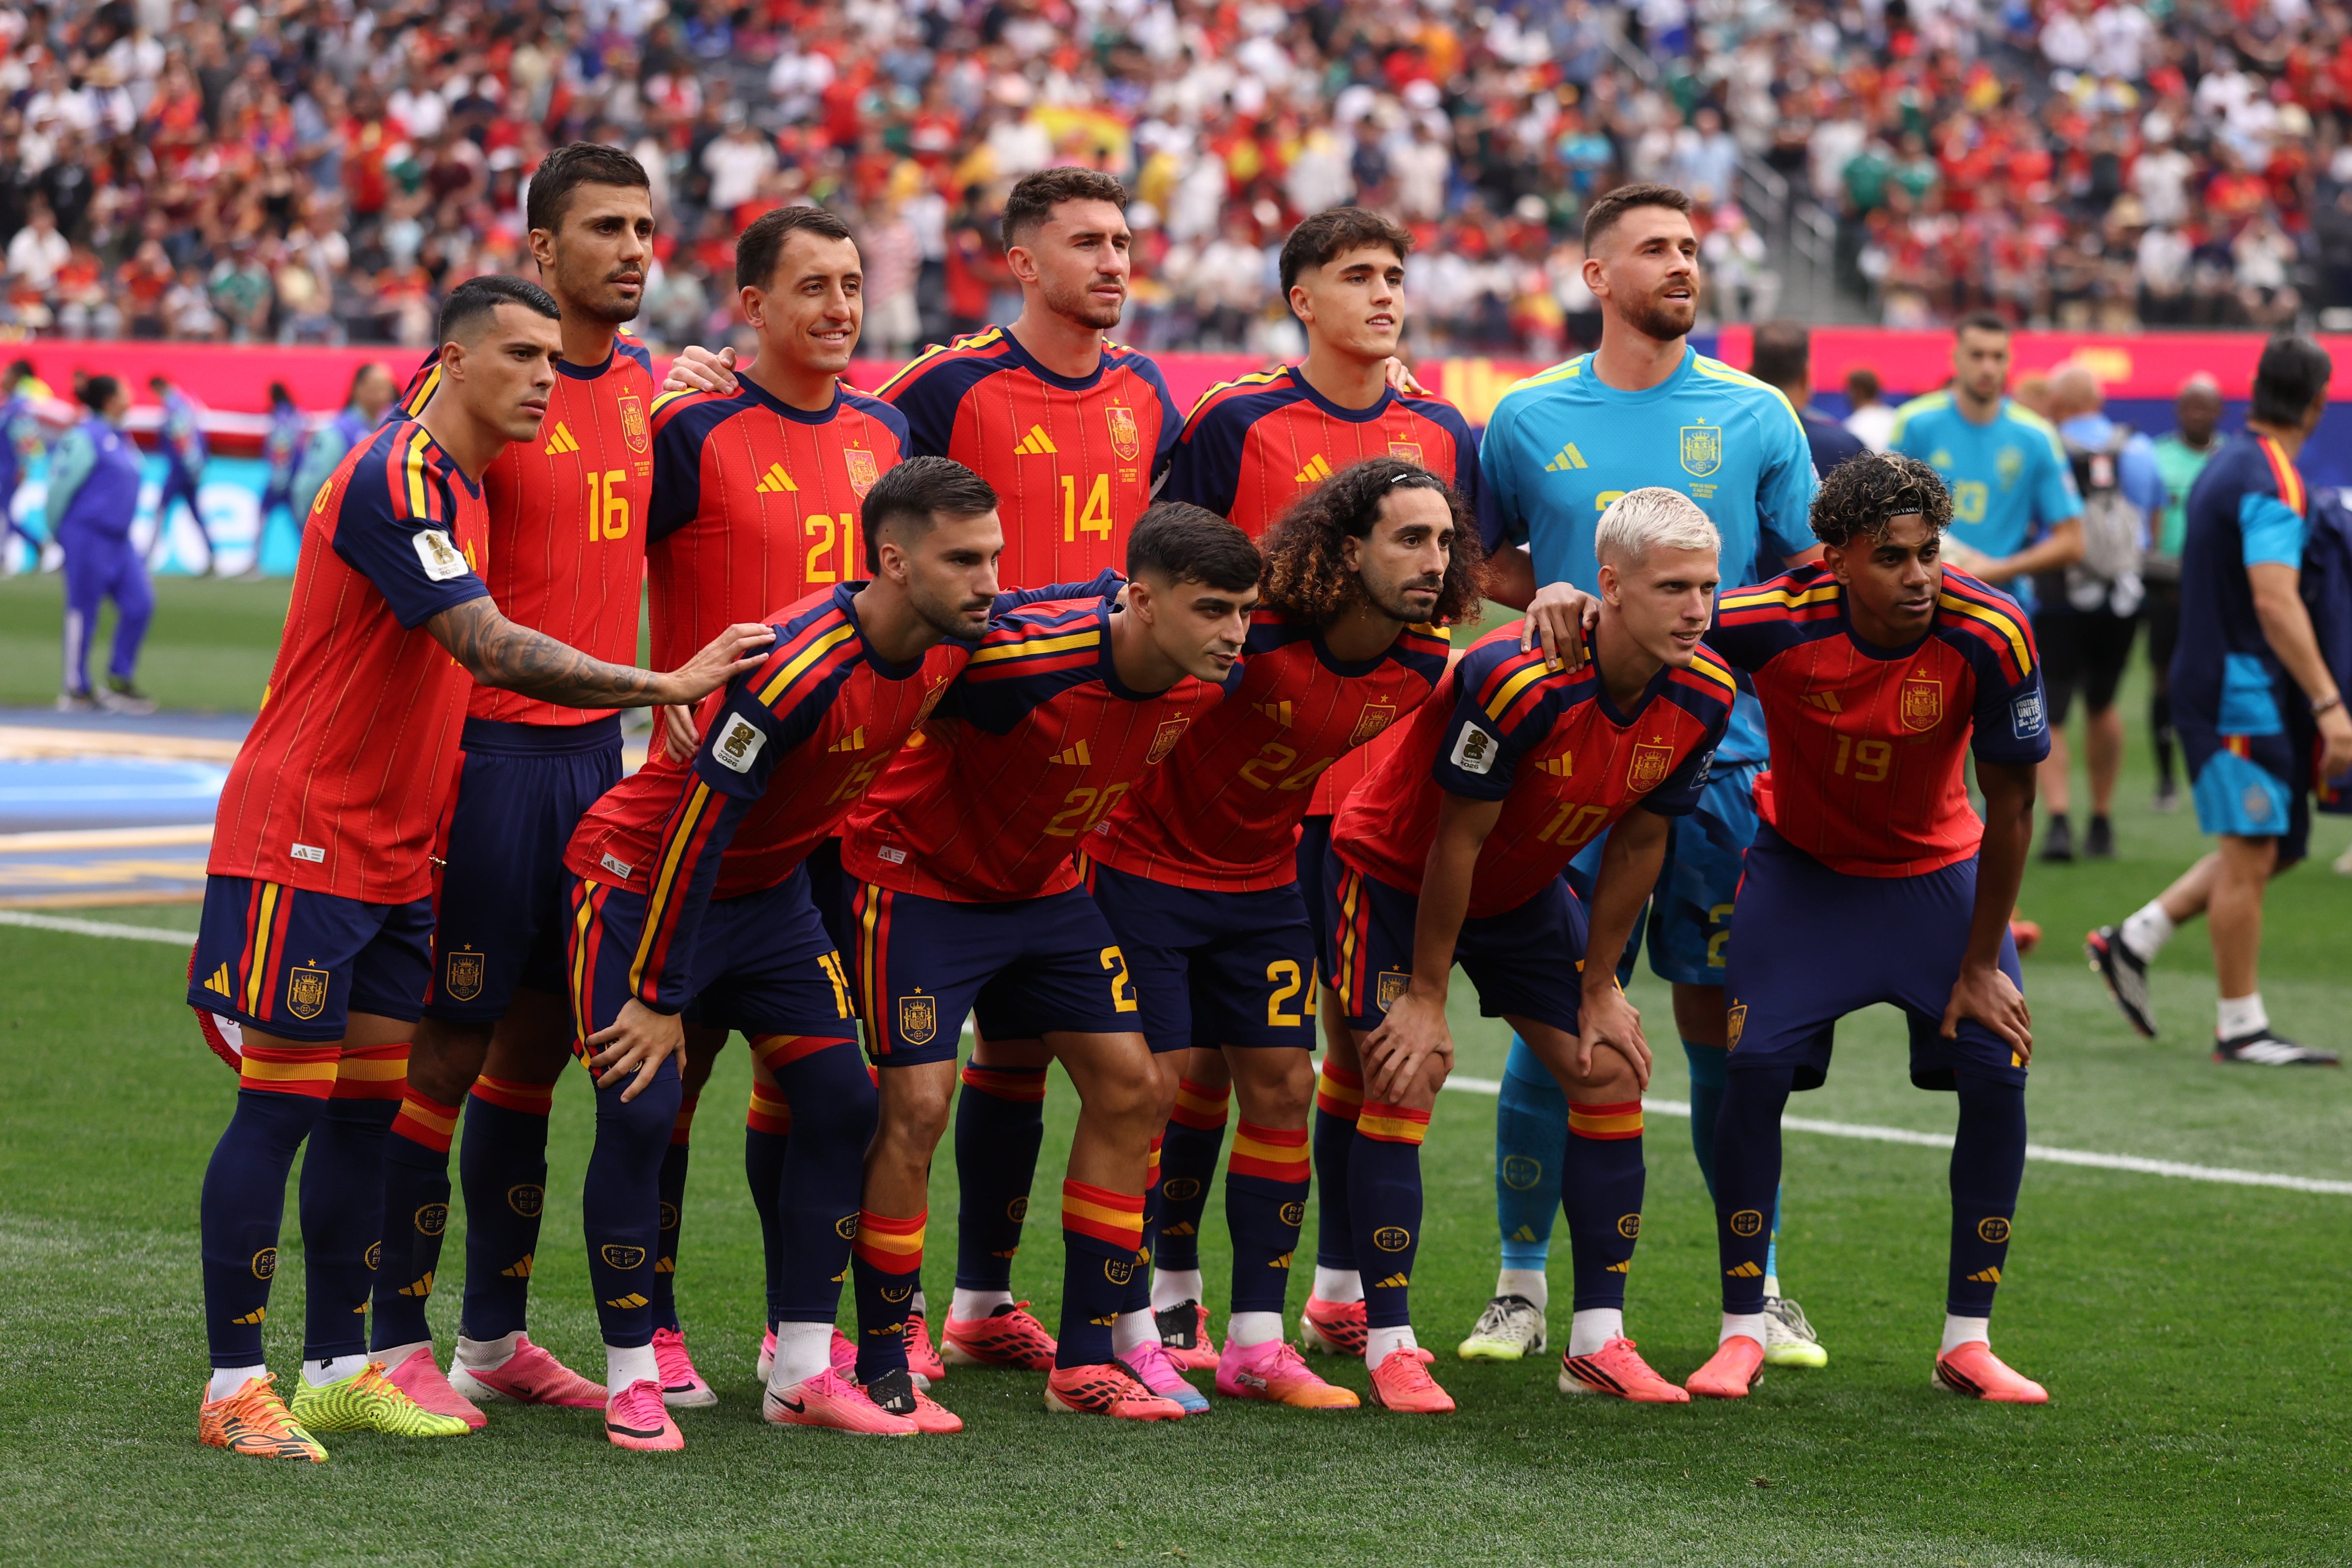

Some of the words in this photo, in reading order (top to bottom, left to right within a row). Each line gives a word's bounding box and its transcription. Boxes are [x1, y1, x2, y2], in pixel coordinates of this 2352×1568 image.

[587, 469, 629, 542] 16
[1061, 474, 1112, 542] 14
[805, 513, 854, 583] 21
[718, 752, 738, 767] 2026
[720, 749, 732, 759] WORLD
[729, 746, 739, 754] FIFA
[1238, 742, 1335, 790] 24
[1834, 734, 1893, 782] 19
[825, 748, 890, 805] 15
[1043, 782, 1130, 836] 20
[1536, 802, 1609, 845] 10
[1100, 945, 1137, 1012] 2
[425, 1217, 443, 1228] EF
